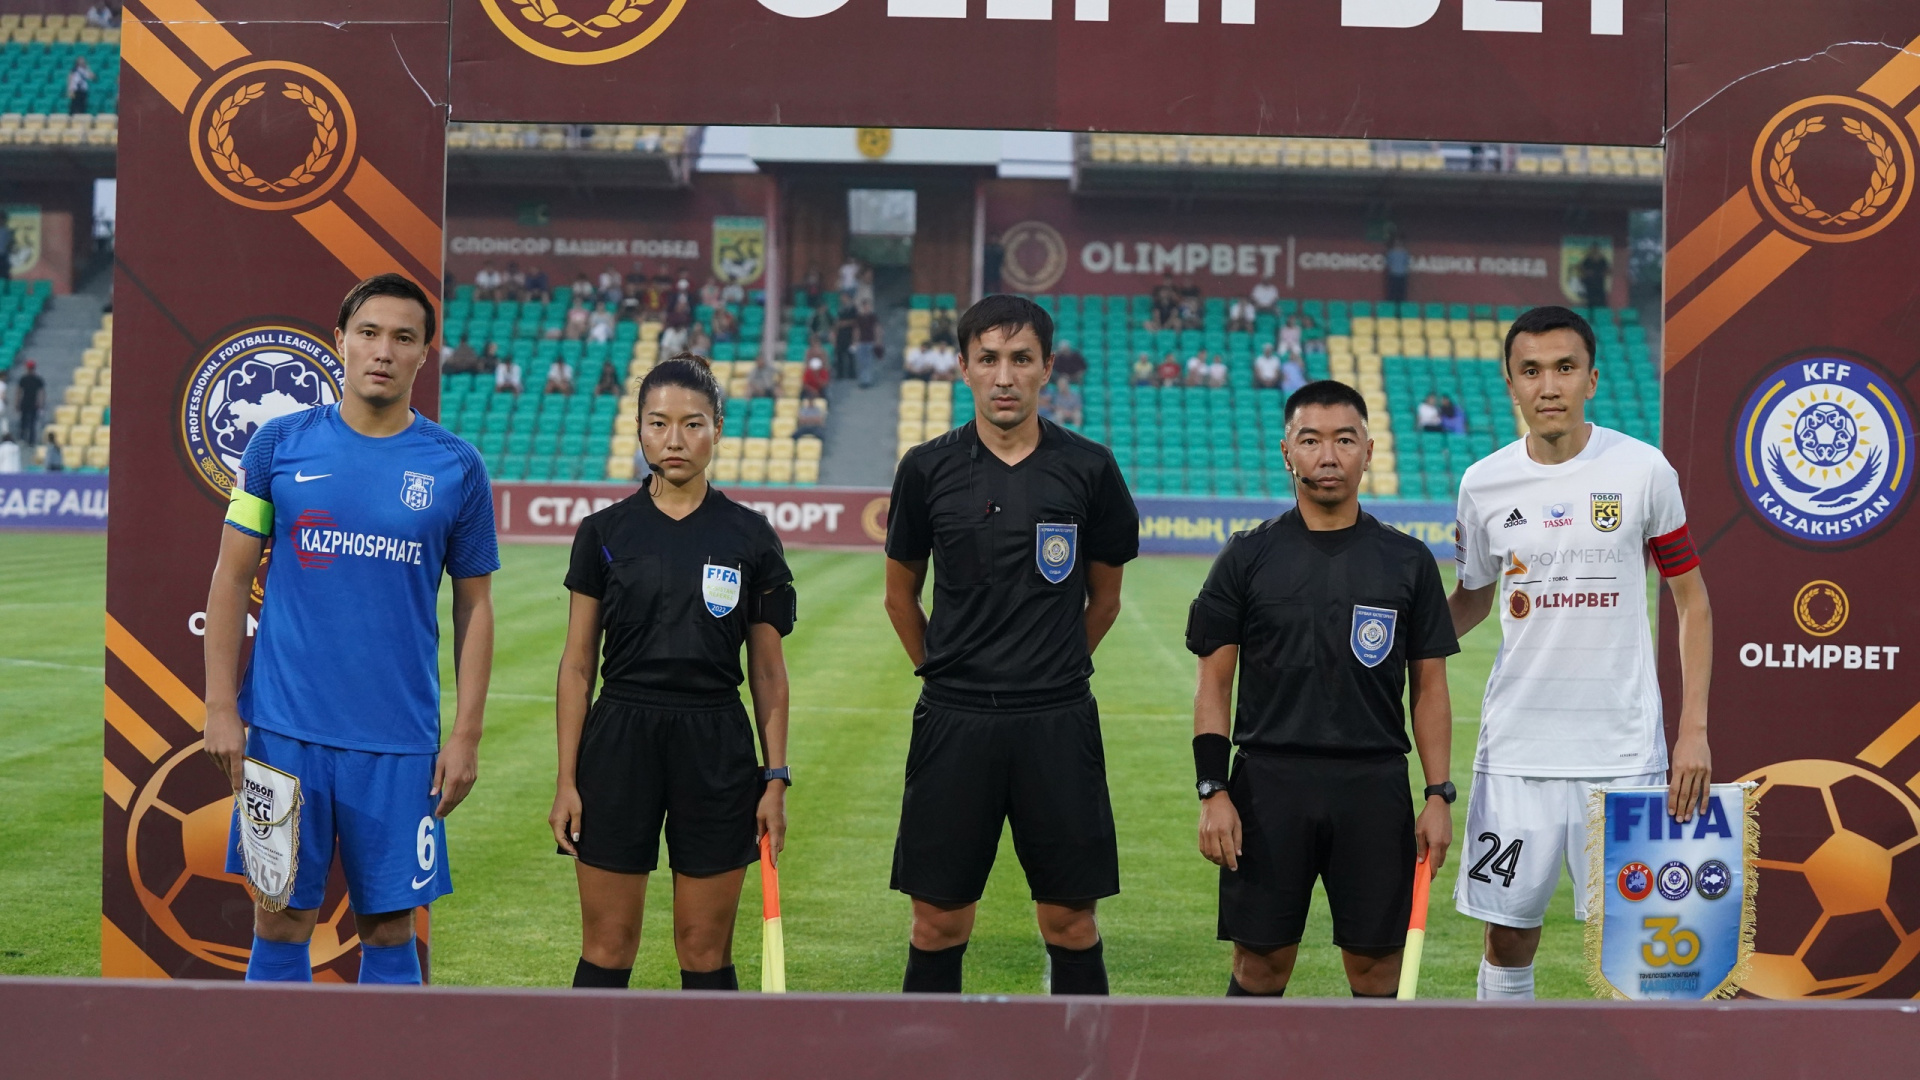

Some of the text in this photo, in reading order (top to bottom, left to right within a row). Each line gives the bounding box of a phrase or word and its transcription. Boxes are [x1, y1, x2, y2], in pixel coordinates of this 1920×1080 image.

[1080, 240, 1282, 277] OLIMPBET
[1802, 362, 1851, 382] KFF
[189, 358, 221, 442] PROFESSIONAL
[218, 333, 275, 362] FOOTBALL
[278, 334, 319, 358] LEAGUE
[320, 354, 336, 367] OF
[1503, 518, 1528, 529] adidas
[1543, 518, 1574, 529] TASSAY
[1758, 492, 1891, 535] KAZAKHSTAN
[301, 527, 423, 565] KAZPHOSPHATE
[1530, 548, 1624, 569] POLYMETAL
[707, 567, 738, 585] FIFA
[711, 604, 727, 614] 2022
[1739, 642, 1900, 670] OLIMPBET
[245, 778, 274, 799] ТОБОЛ
[416, 815, 435, 871] 6
[1468, 831, 1524, 888] 24
[1622, 864, 1649, 876] UEFA
[1642, 917, 1700, 967] 30
